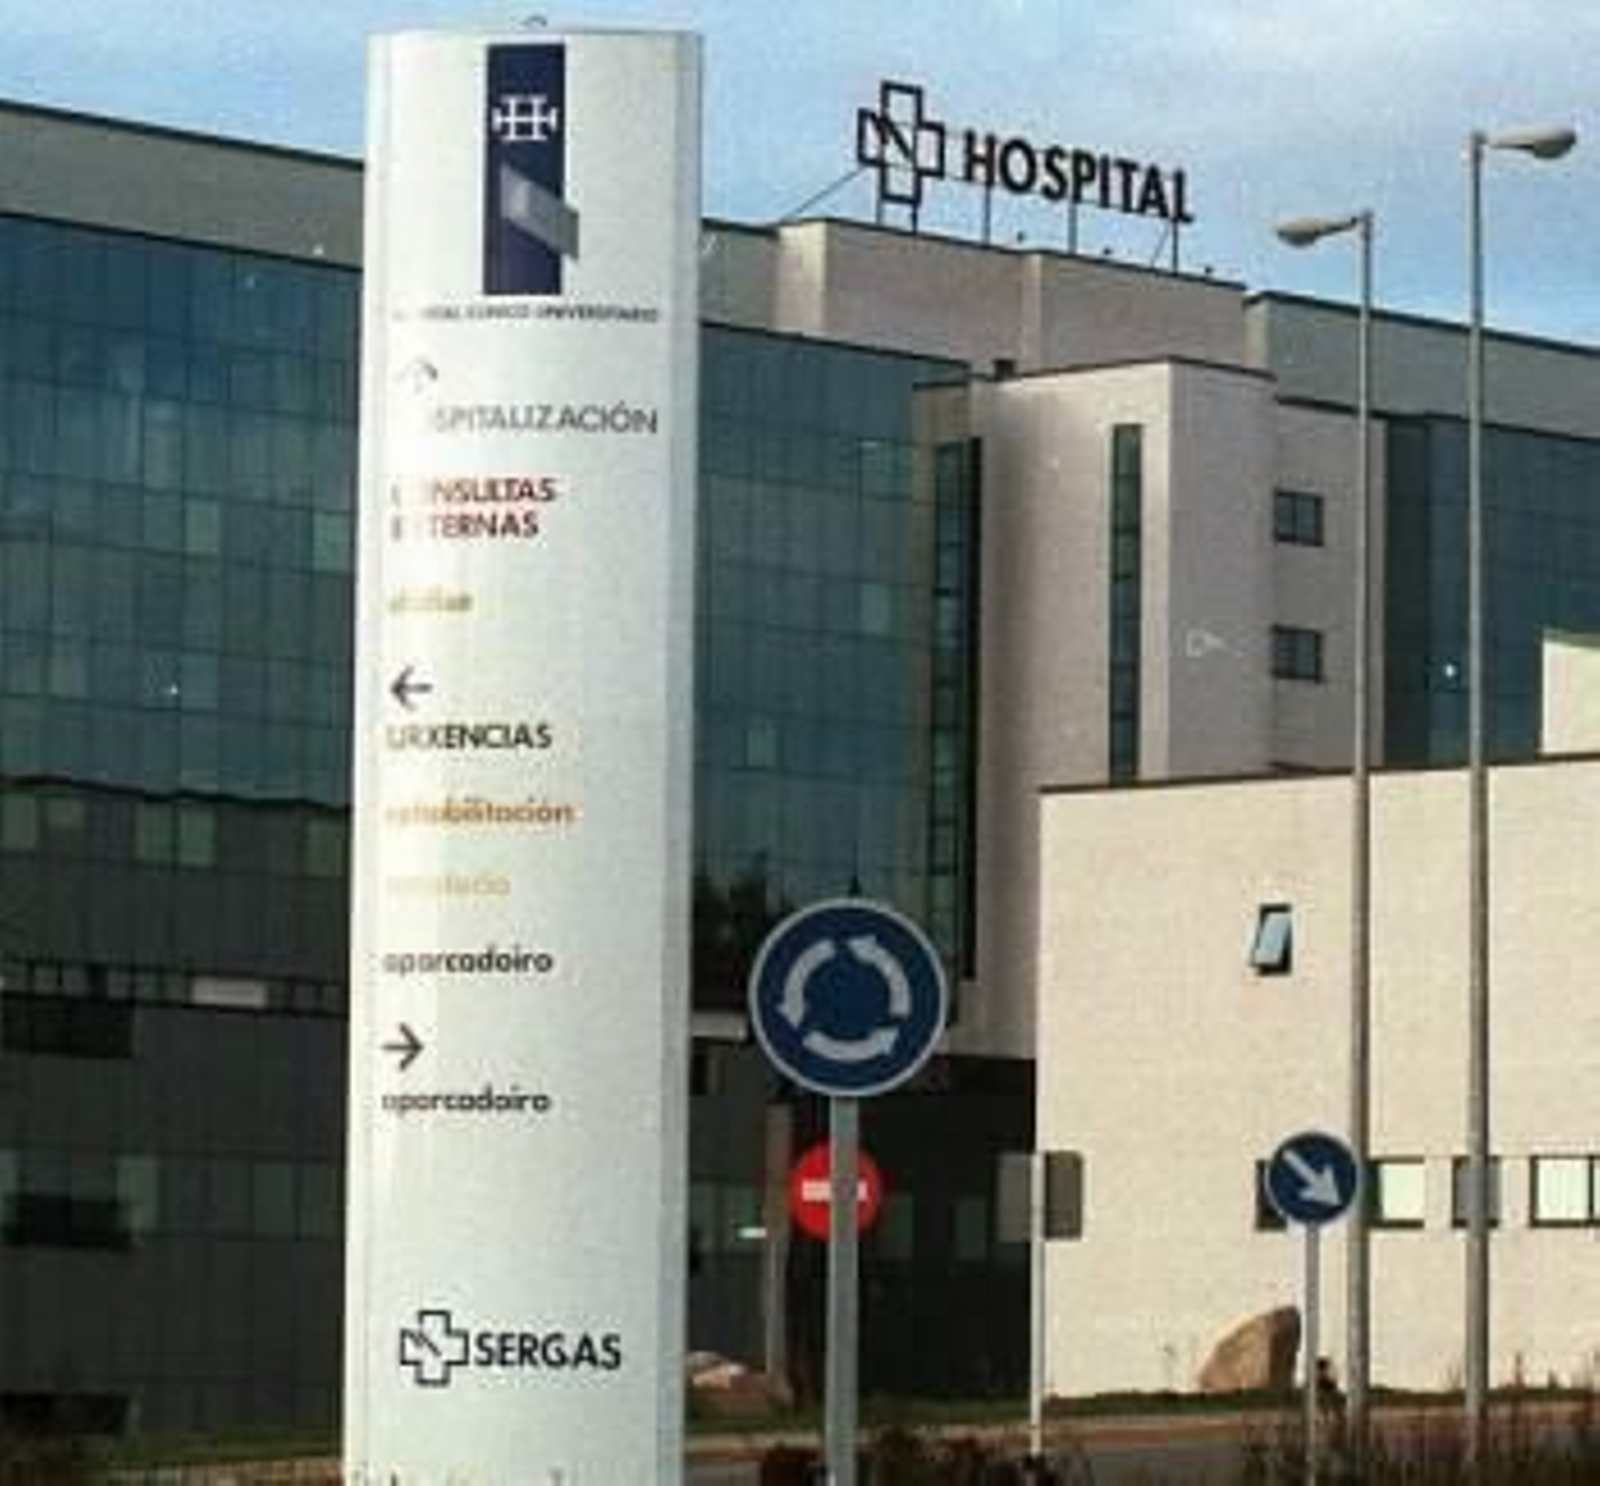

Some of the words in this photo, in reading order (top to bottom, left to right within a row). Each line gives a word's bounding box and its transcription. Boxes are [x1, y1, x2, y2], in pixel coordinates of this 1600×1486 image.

[964, 128, 1194, 223] HOSPITAL
[386, 722, 552, 749] URXENCIAS
[474, 1331, 622, 1370] SERGAS
